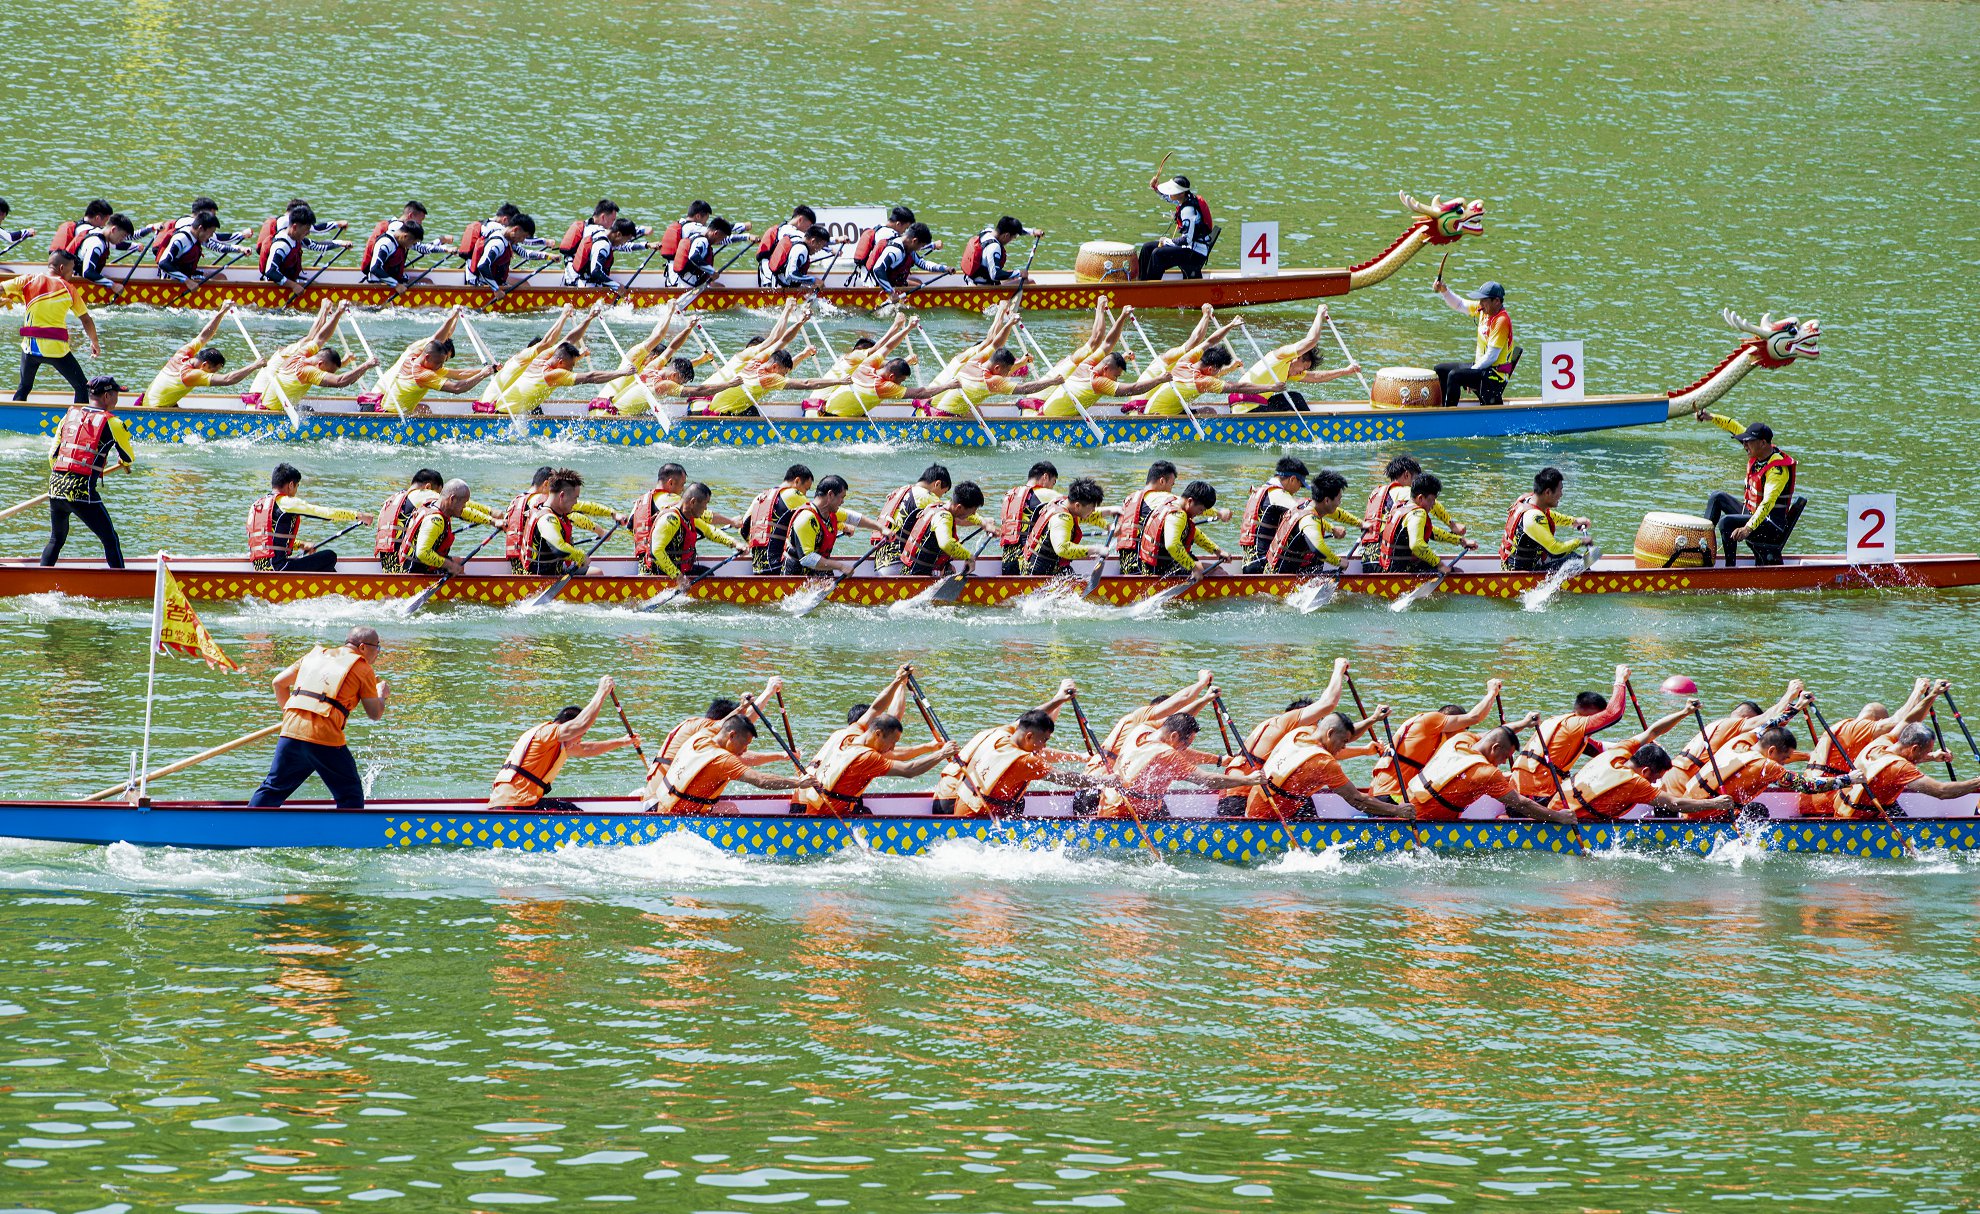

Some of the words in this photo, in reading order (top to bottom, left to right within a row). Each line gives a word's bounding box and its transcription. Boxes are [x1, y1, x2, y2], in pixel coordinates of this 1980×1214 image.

[1247, 233, 1271, 264] 4
[1551, 353, 1576, 390] 3
[1857, 509, 1886, 548] 2
